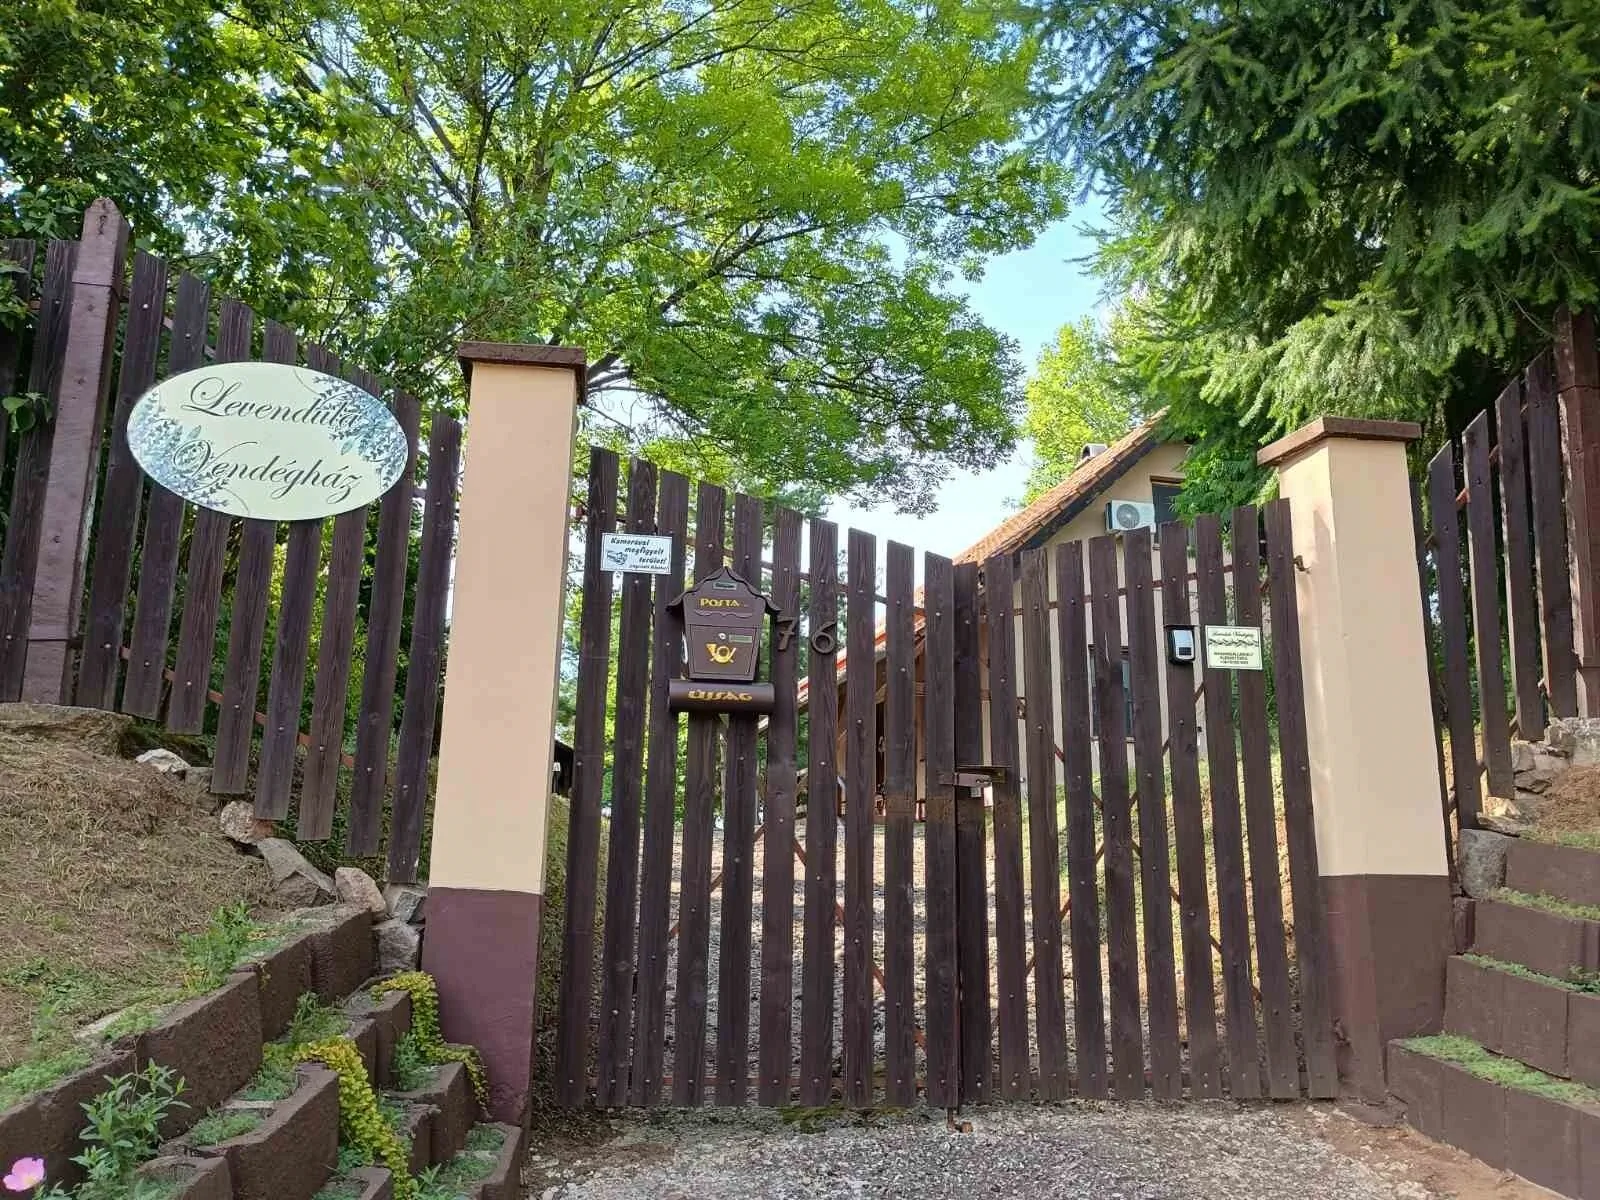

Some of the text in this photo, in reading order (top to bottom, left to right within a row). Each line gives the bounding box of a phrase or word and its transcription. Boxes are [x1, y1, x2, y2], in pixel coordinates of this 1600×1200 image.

[181, 377, 358, 427] Levendula
[173, 441, 361, 505] Vendégház
[700, 598, 741, 608] POSTA
